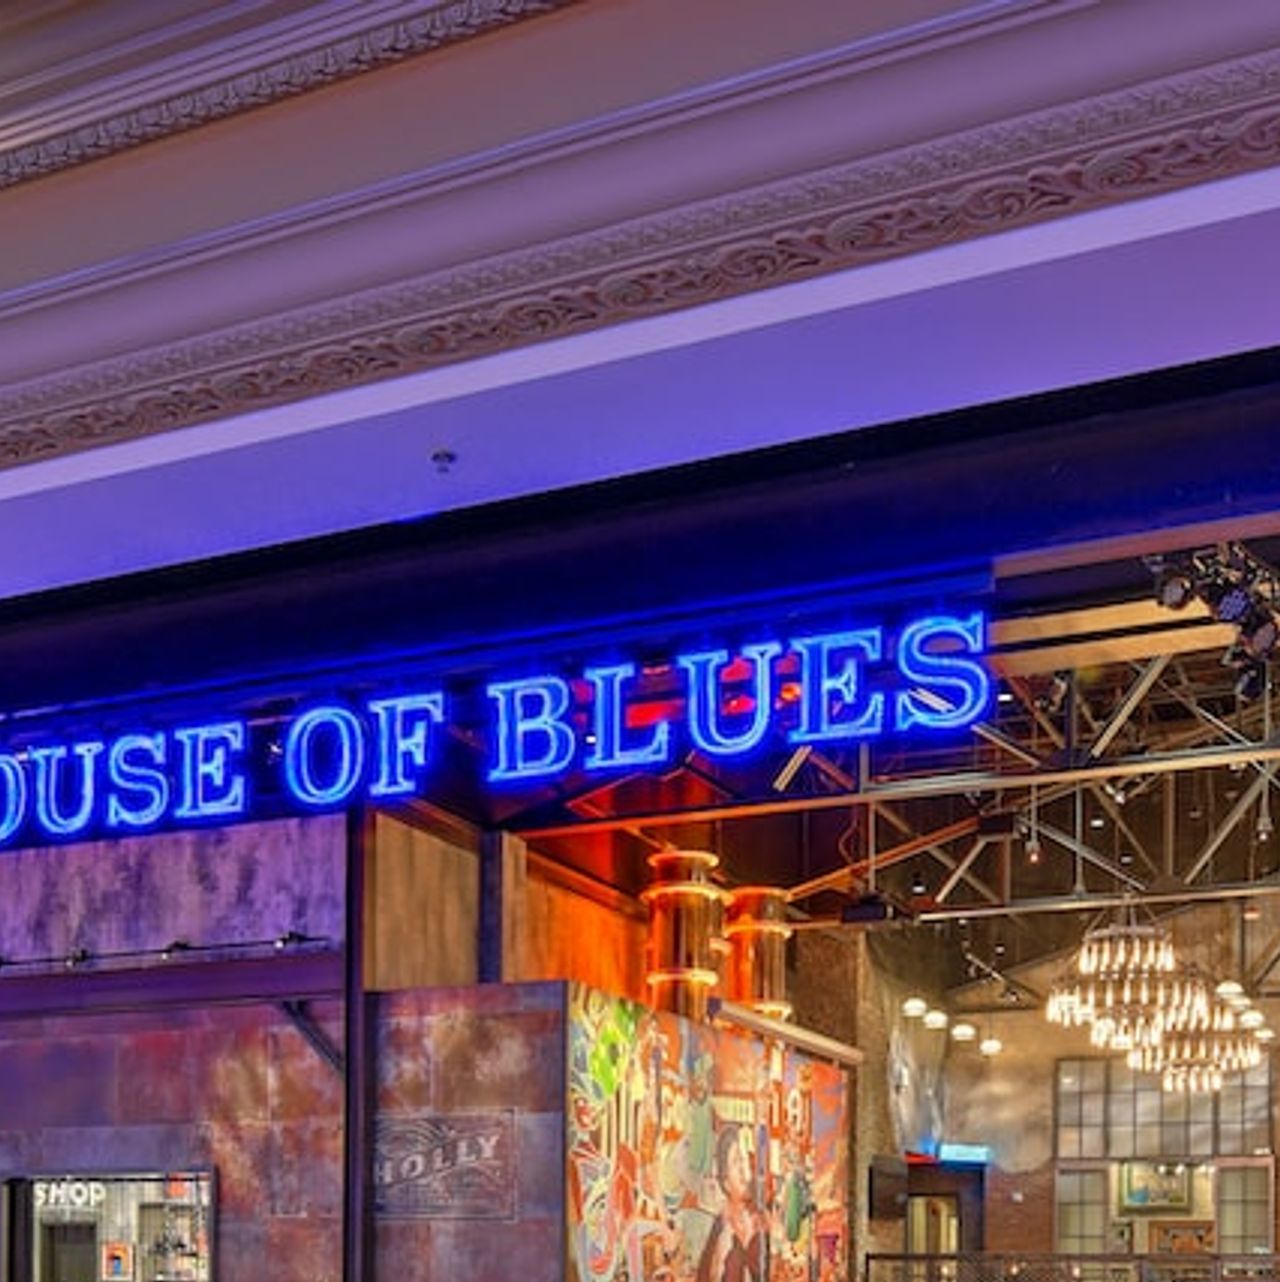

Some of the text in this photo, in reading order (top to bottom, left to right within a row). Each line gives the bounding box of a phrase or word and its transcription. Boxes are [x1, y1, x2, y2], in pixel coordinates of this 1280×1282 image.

[284, 692, 444, 804] OF
[485, 610, 989, 783] BLUES
[33, 1181, 107, 1207] SHOP
